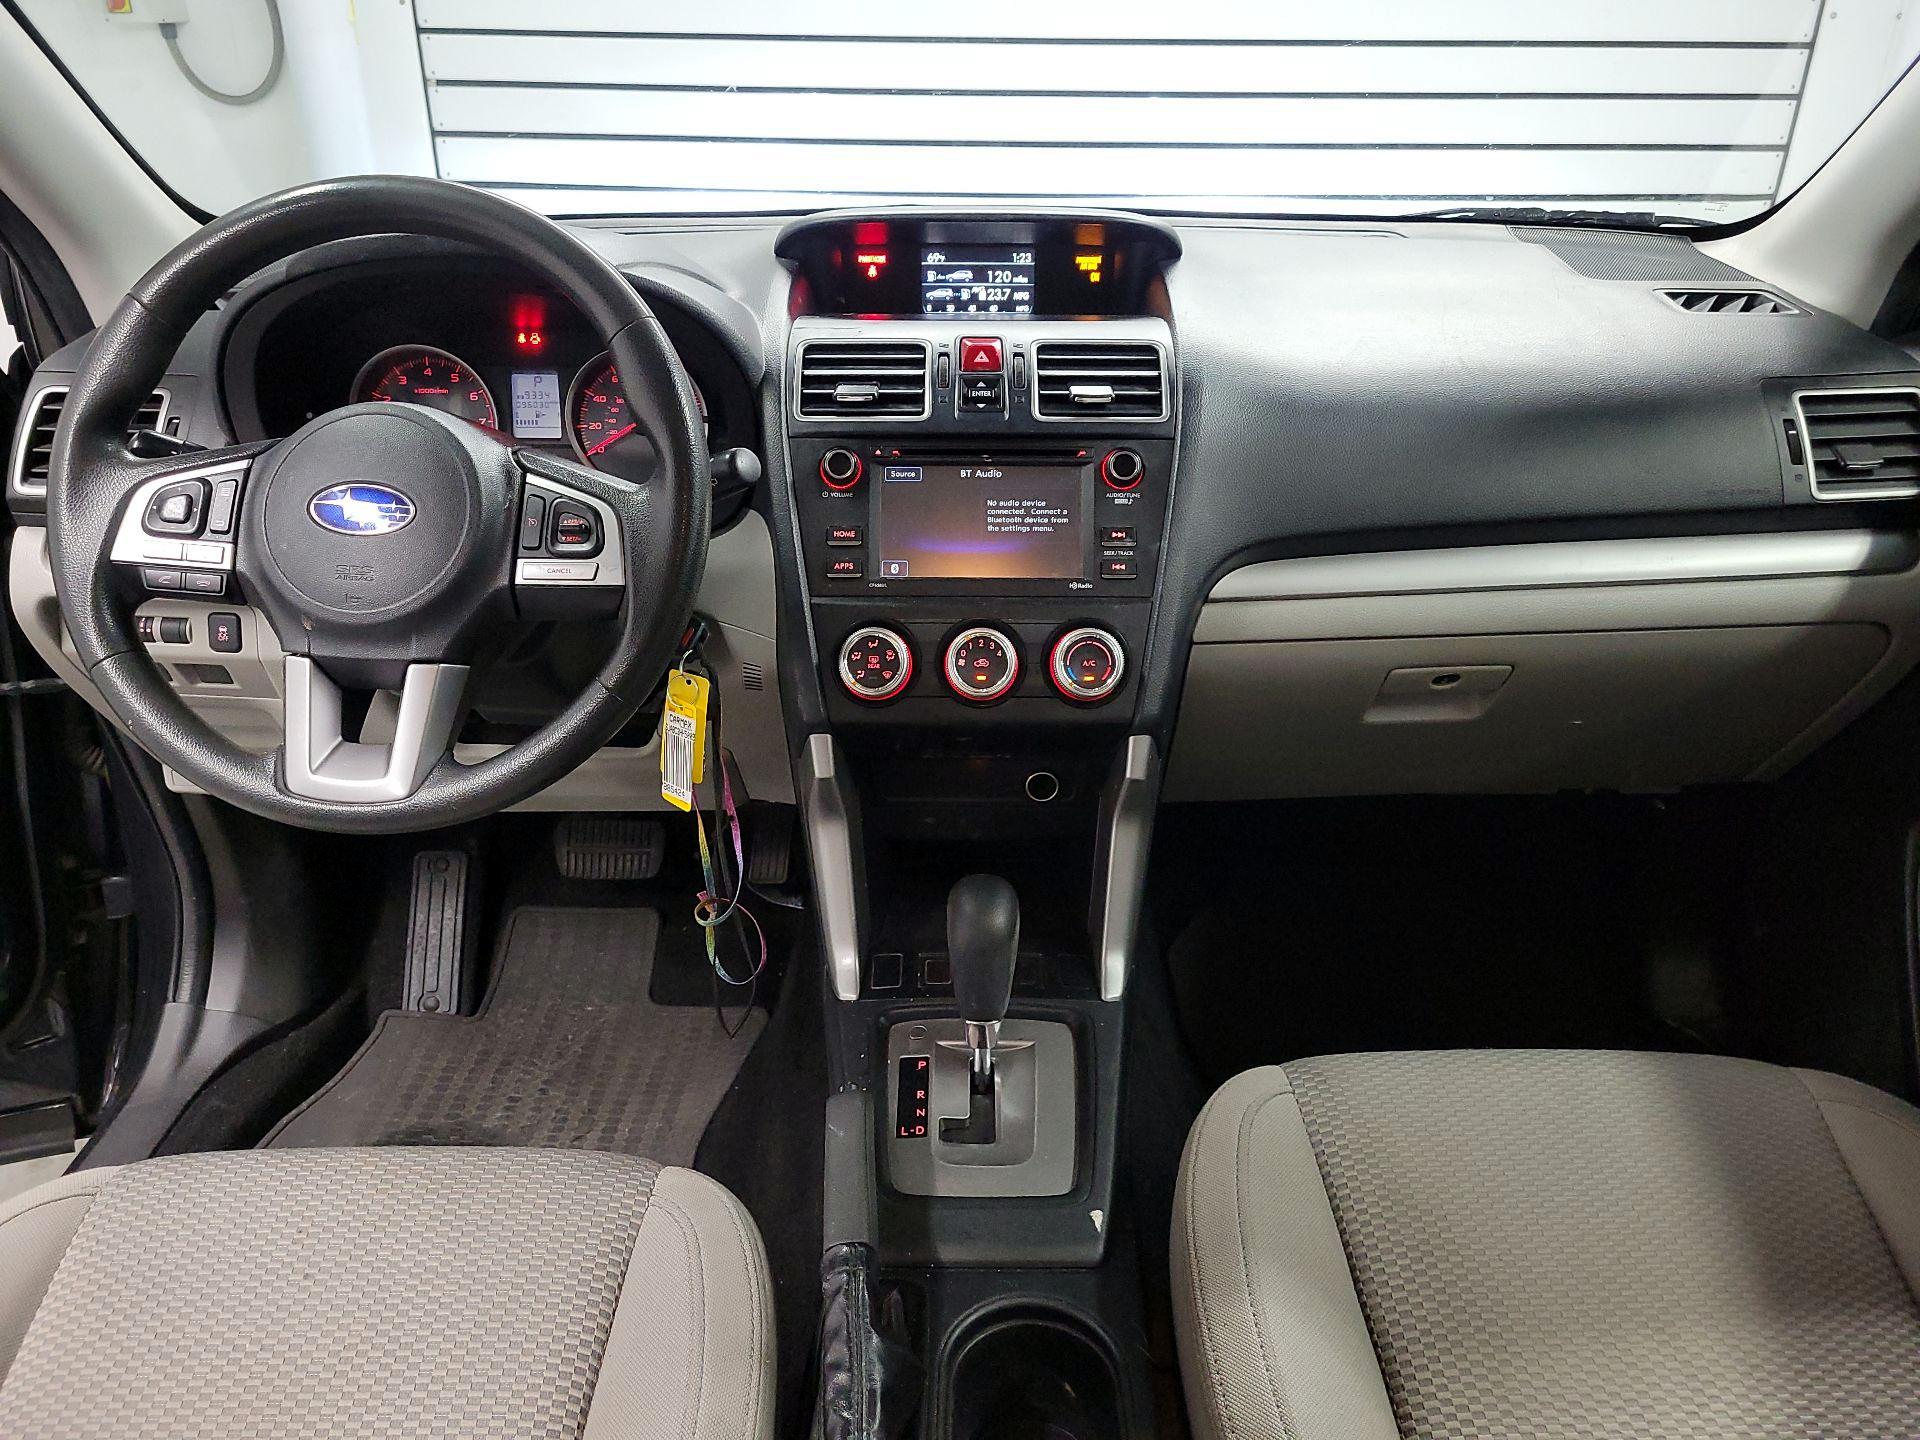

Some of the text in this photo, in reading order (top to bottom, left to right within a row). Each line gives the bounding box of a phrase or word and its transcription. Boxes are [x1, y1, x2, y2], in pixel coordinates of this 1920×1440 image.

[1012, 252, 1032, 263] 1:23
[987, 270, 1012, 283] 120
[987, 288, 1012, 300] 23.7
[424, 367, 432, 377] 4
[398, 376, 407, 385] 3
[450, 373, 460, 383] 5
[534, 375, 543, 387] P
[469, 392, 479, 401] 6
[593, 395, 607, 403] 40
[588, 422, 602, 430] 20
[890, 470, 916, 478] Source
[960, 469, 1002, 478] BT Audio
[987, 499, 1046, 507] No audio device
[987, 524, 999, 532] the
[1001, 524, 1030, 533] settings
[833, 530, 856, 538] HOME
[834, 562, 854, 570] APPS
[978, 639, 984, 647] 2
[989, 641, 995, 650] 3
[960, 649, 967, 657] 0
[917, 1060, 927, 1071] P
[916, 1090, 926, 1099] R
[916, 1108, 926, 1117] N
